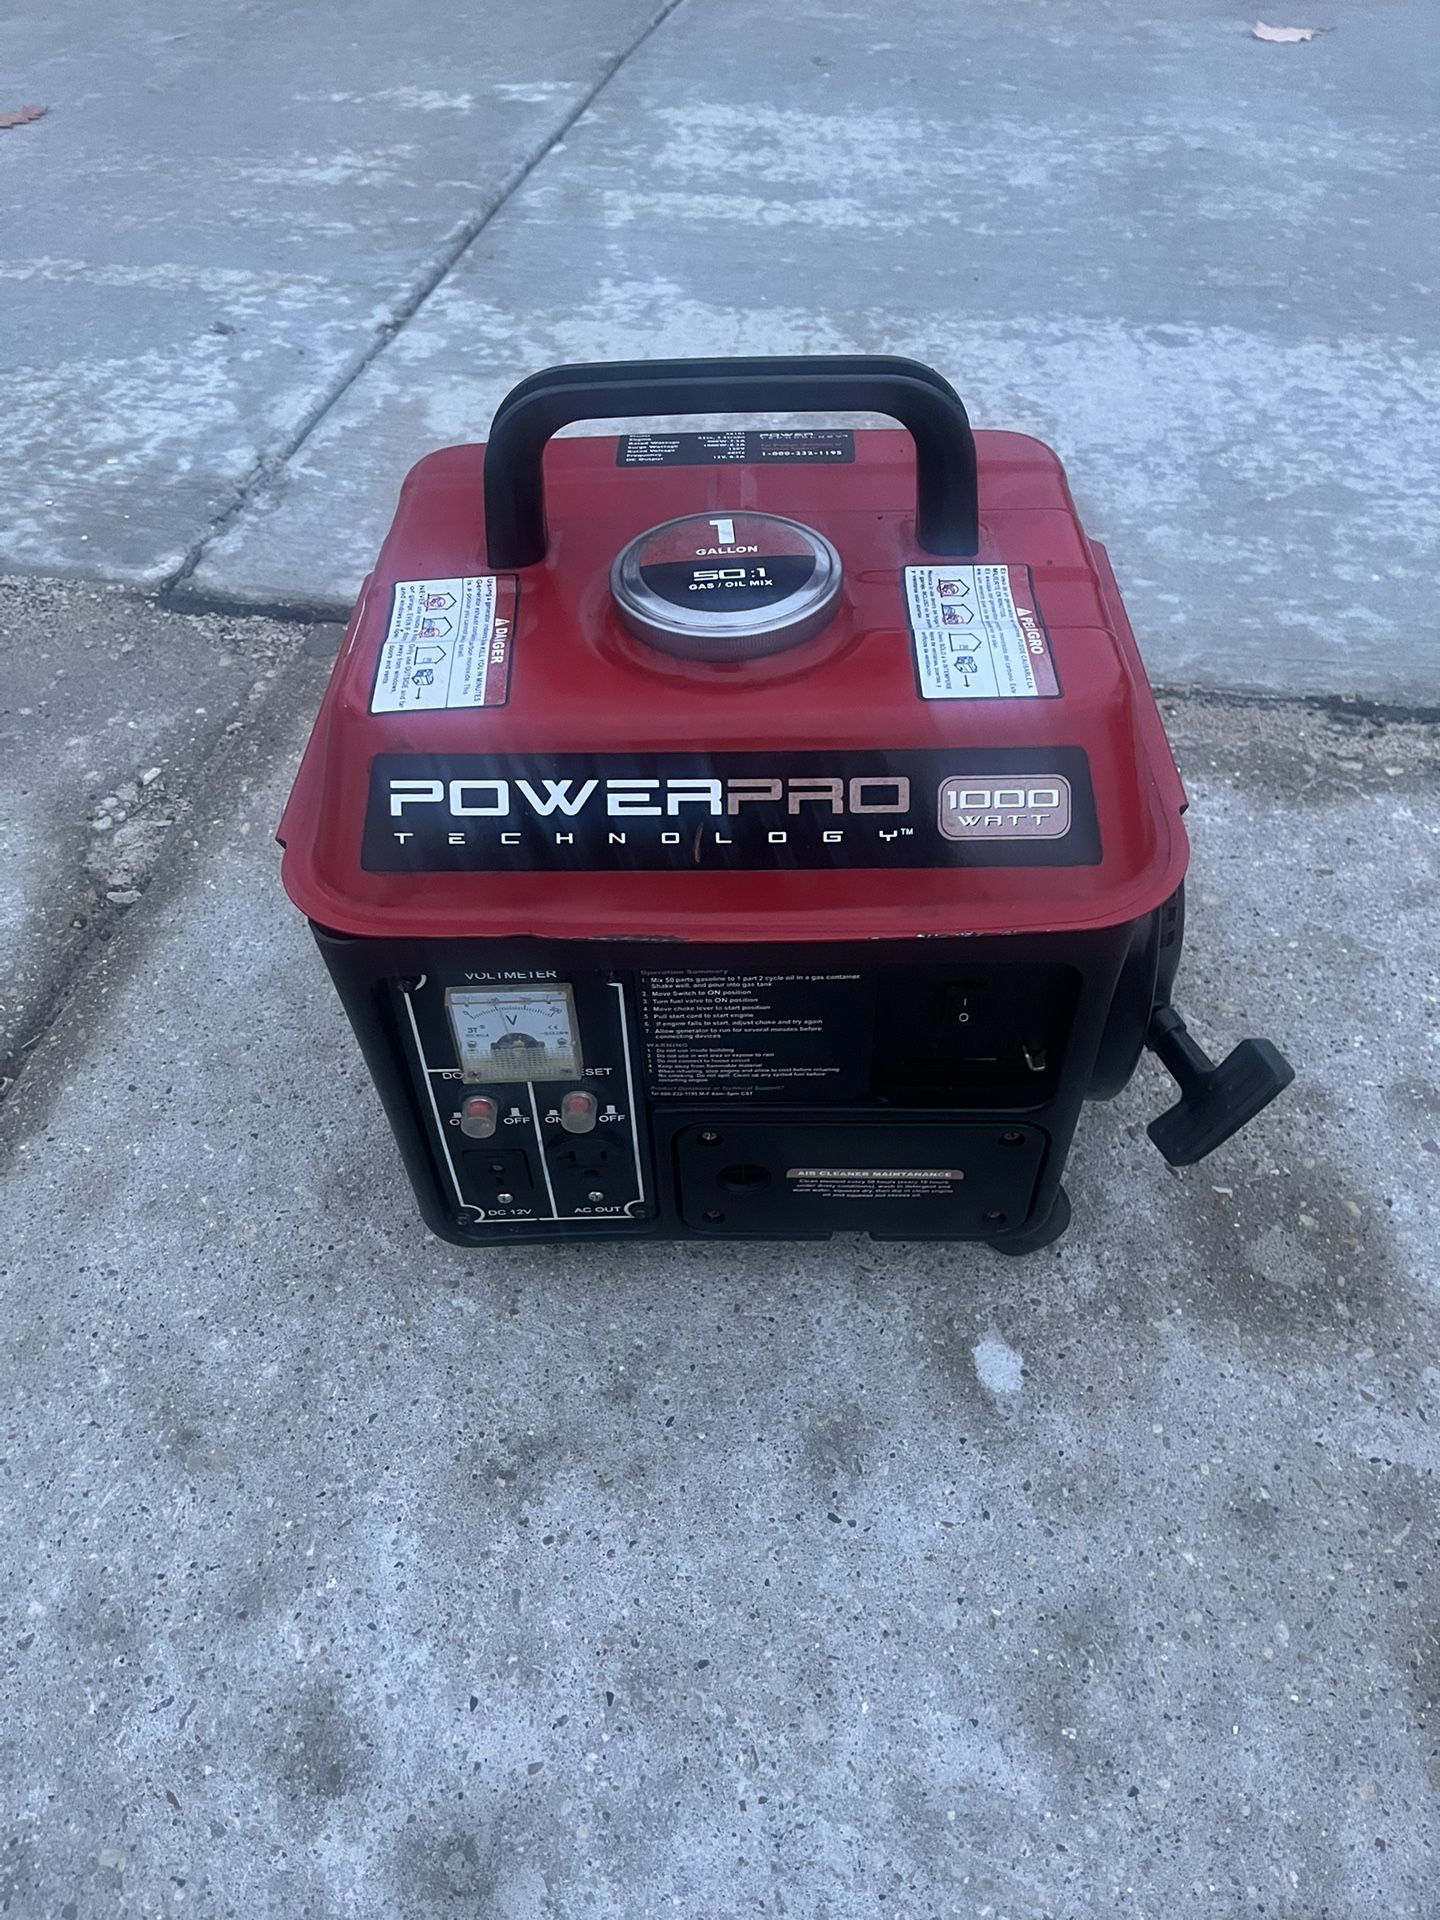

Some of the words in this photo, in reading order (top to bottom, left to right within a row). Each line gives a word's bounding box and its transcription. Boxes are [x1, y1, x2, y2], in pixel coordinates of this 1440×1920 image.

[710, 519, 735, 544] 1
[696, 546, 758, 555] GALLON
[693, 567, 766, 581] 50:1
[688, 583, 714, 591] GAS
[948, 790, 1059, 809] 1000
[958, 815, 1050, 826] WATT
[465, 970, 557, 980] VOLTMETER
[506, 1015, 517, 1025] V
[449, 1118, 462, 1126] O
[504, 1117, 530, 1125] OFF
[598, 1115, 626, 1123] OFF
